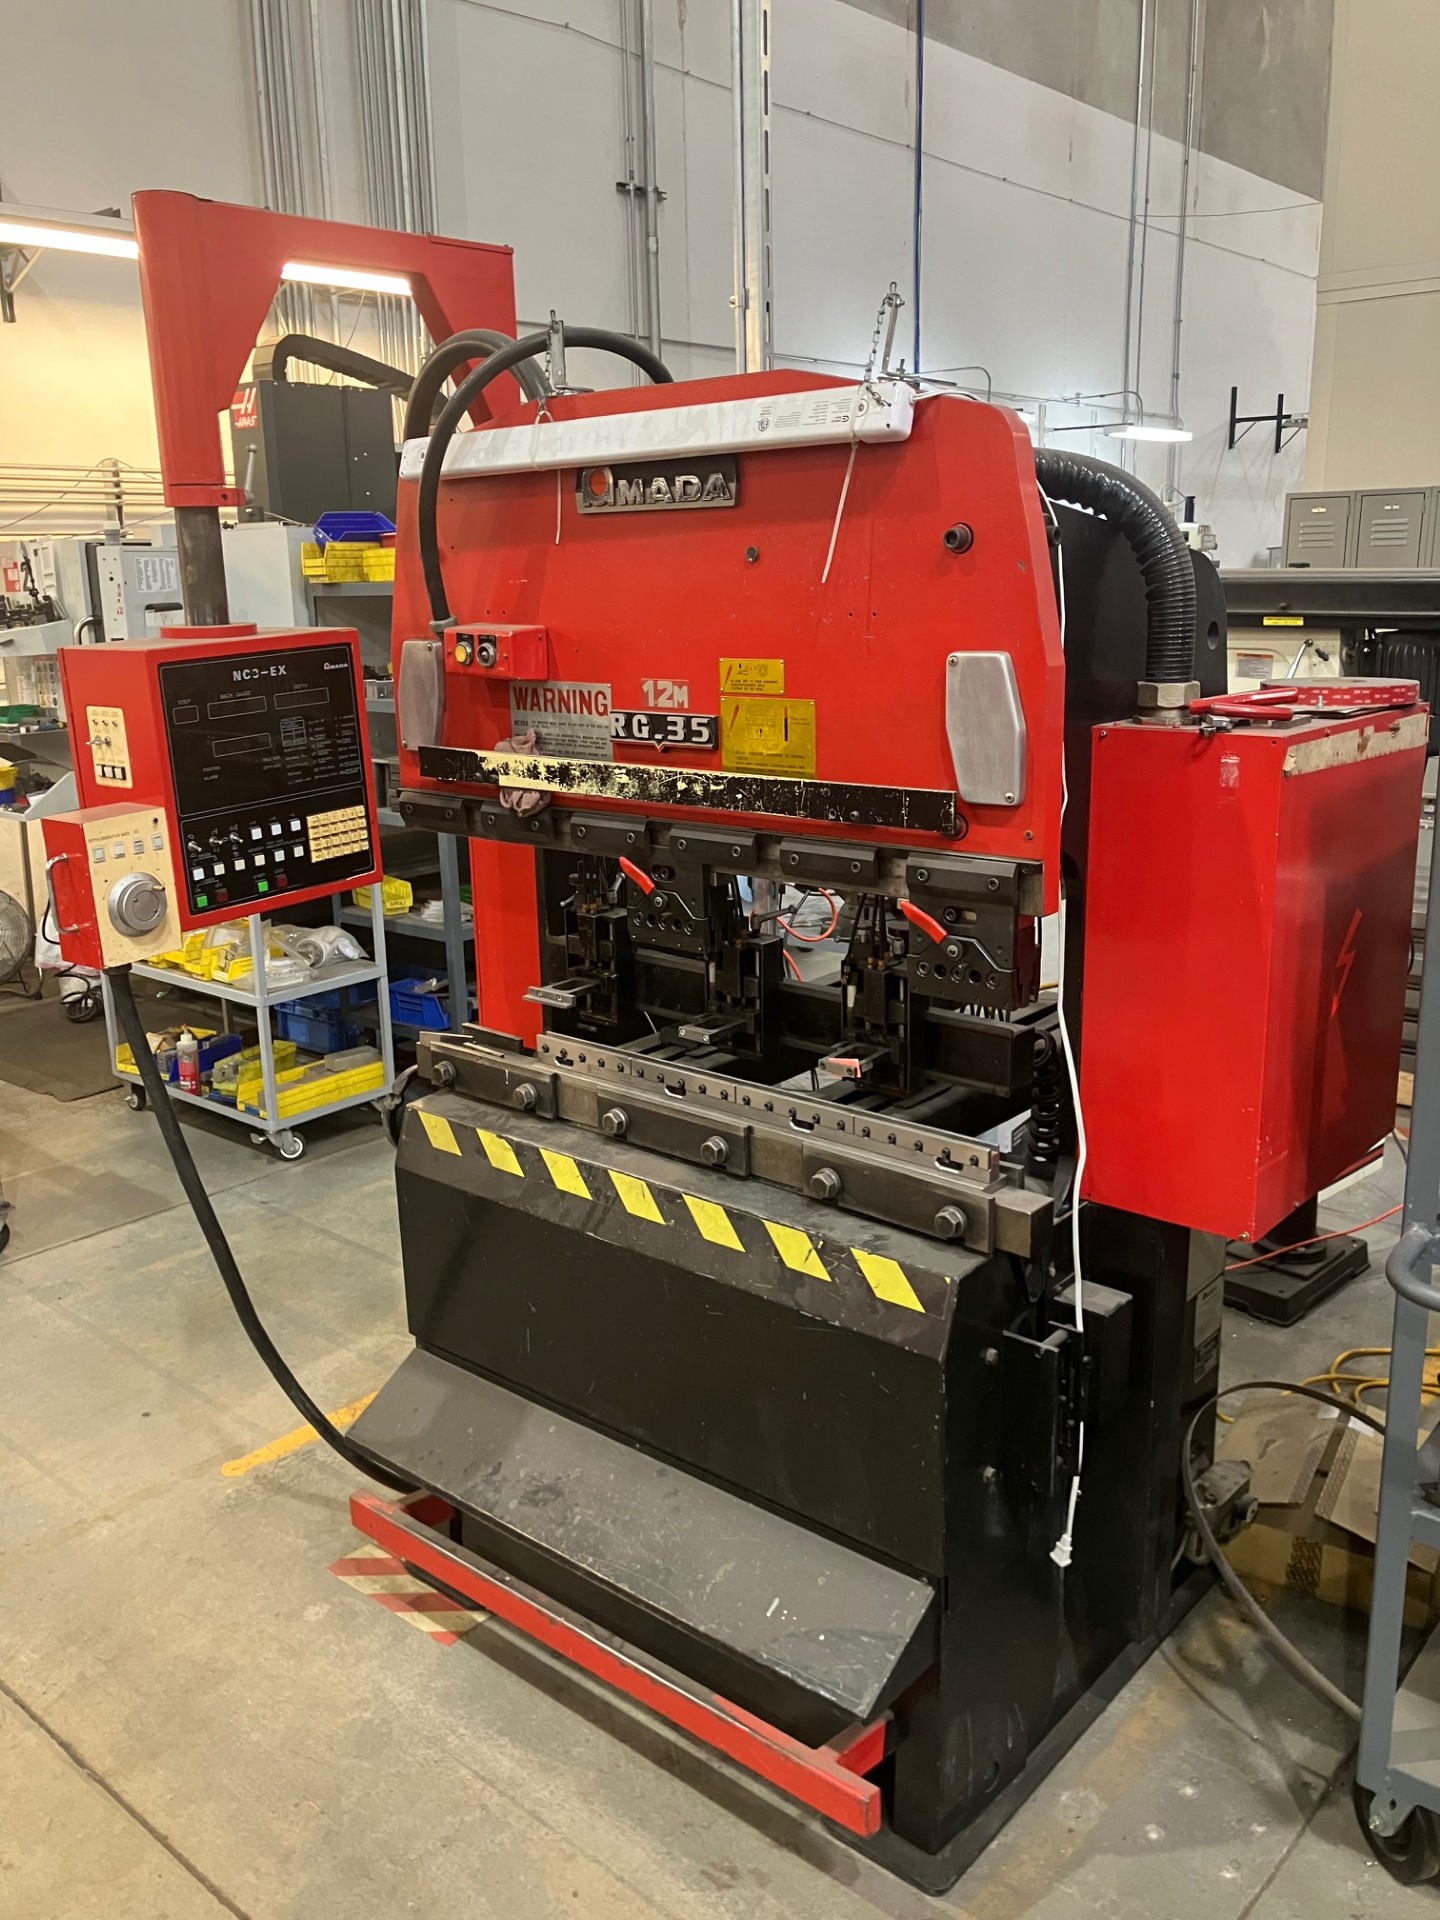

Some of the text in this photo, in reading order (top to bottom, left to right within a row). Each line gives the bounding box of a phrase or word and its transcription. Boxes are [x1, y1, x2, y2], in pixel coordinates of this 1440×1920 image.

[582, 466, 732, 508] AMADA
[513, 686, 609, 717] WARNING
[610, 712, 711, 743] RG.35
